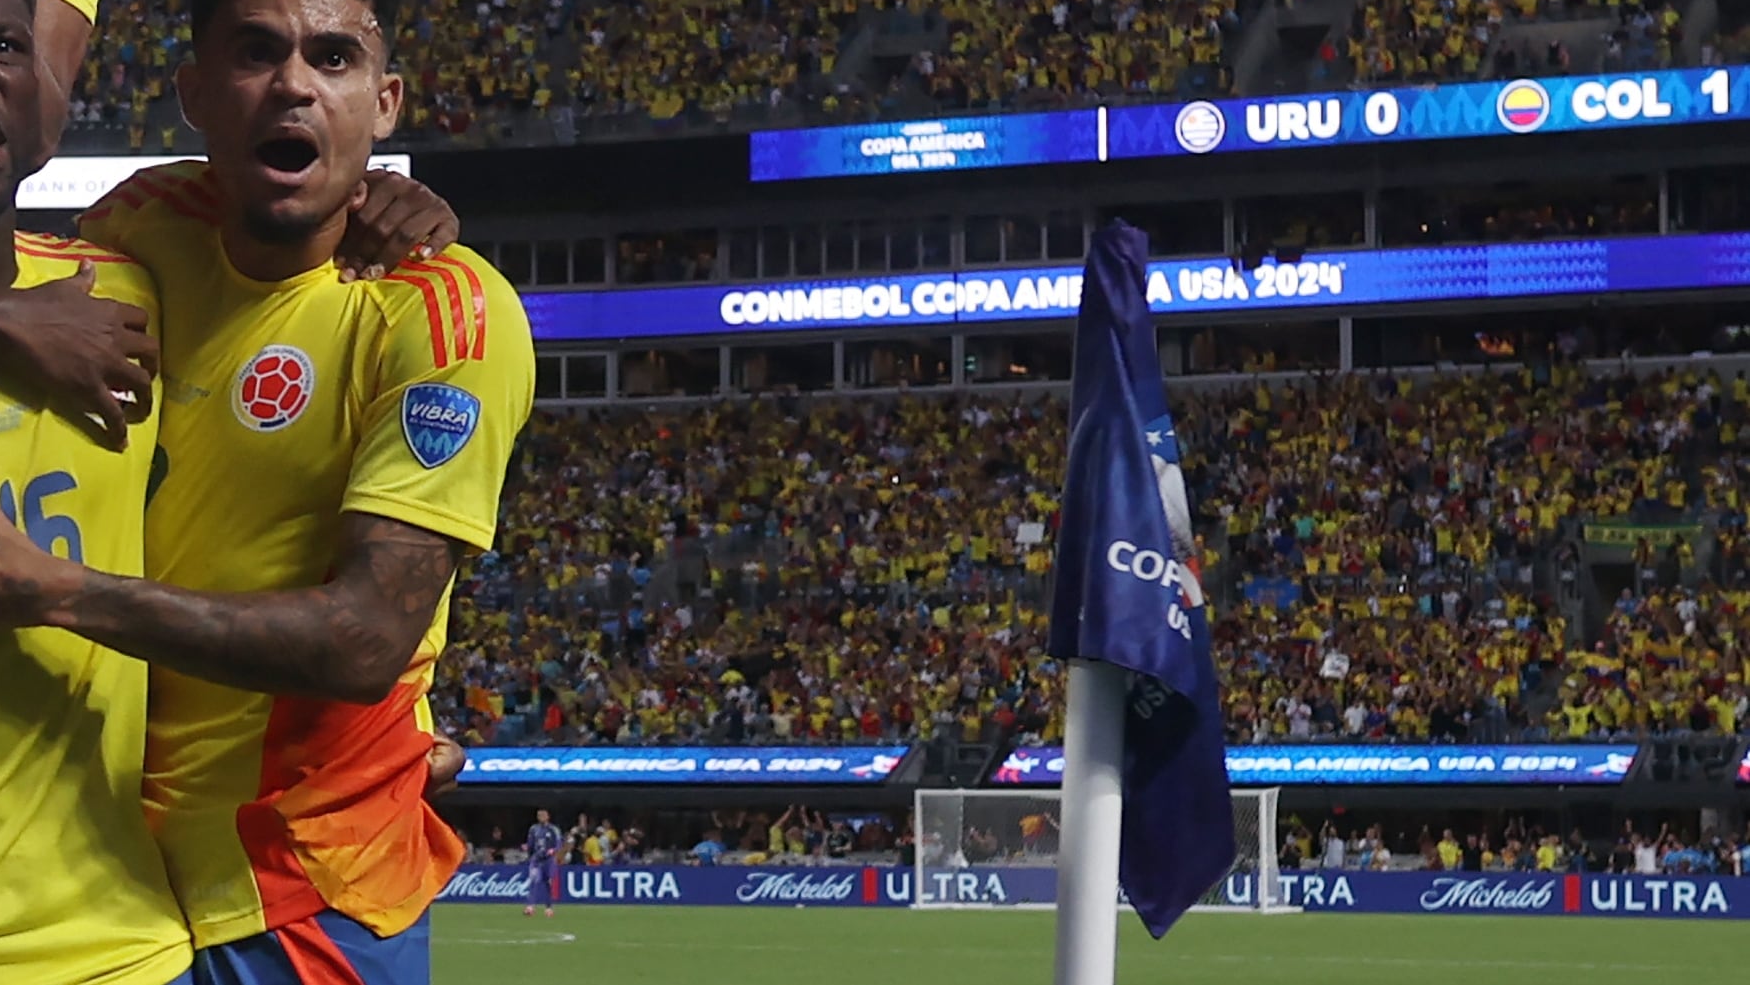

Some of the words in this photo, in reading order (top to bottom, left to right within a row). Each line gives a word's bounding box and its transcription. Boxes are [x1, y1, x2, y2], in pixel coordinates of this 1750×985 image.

[1572, 79, 1671, 122] COL
[1701, 70, 1729, 114] 1
[1246, 99, 1340, 143] URU
[1364, 92, 1398, 135] 0
[860, 137, 909, 156] COPA
[909, 131, 986, 153] AMERICA
[25, 181, 76, 193] BANK
[720, 284, 909, 325] CONMEBOL
[911, 277, 1011, 316] COPA
[1178, 264, 1249, 300] USA
[1252, 262, 1343, 297] 2024
[410, 402, 469, 427] VIBRA
[480, 758, 560, 771] COPA
[561, 757, 697, 771] AMERICA
[704, 758, 760, 771] USA
[766, 758, 846, 771] 2024
[1225, 758, 1292, 771] OPA
[1293, 756, 1429, 771] AMERICA
[1438, 757, 1494, 771] USA
[1500, 757, 1576, 771] 2024
[567, 871, 680, 899] ULTRA
[736, 871, 856, 902] Michelob
[1420, 877, 1555, 910] Michelob
[1590, 879, 1729, 912] ULTRA
